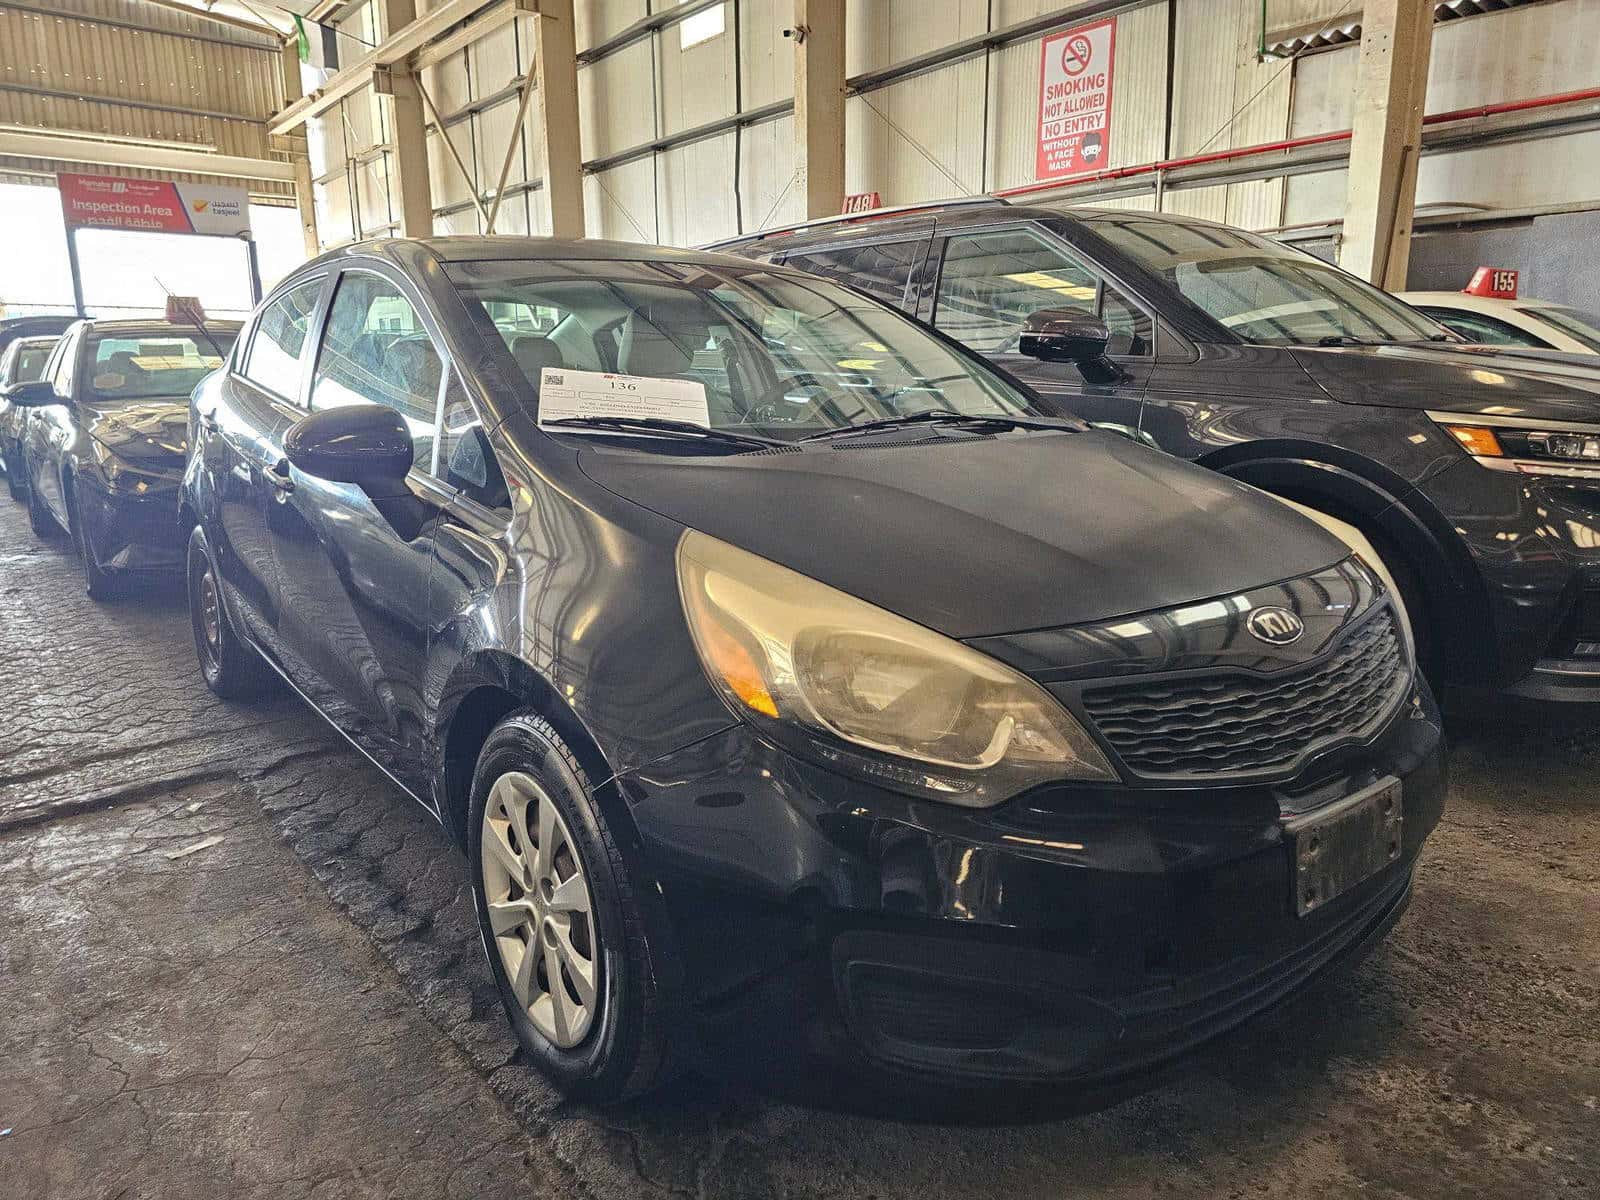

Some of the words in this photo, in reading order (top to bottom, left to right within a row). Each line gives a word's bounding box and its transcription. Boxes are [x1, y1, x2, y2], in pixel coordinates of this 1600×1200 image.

[1047, 73, 1105, 100] SMOKING
[1044, 103, 1063, 119] NOT
[1063, 92, 1105, 115] ALLOWED
[1045, 123, 1061, 138] NO
[1064, 113, 1103, 134] ENTRY
[1042, 136, 1080, 152] WITHOUT
[1047, 151, 1054, 161] A
[1054, 148, 1075, 160] FACE
[1048, 159, 1072, 171] MASK
[72, 198, 141, 214] Inspection
[144, 204, 174, 216] Area
[847, 195, 869, 213] 148
[1493, 271, 1515, 291] 155
[610, 381, 637, 391] 136
[1254, 610, 1301, 637] KIA
